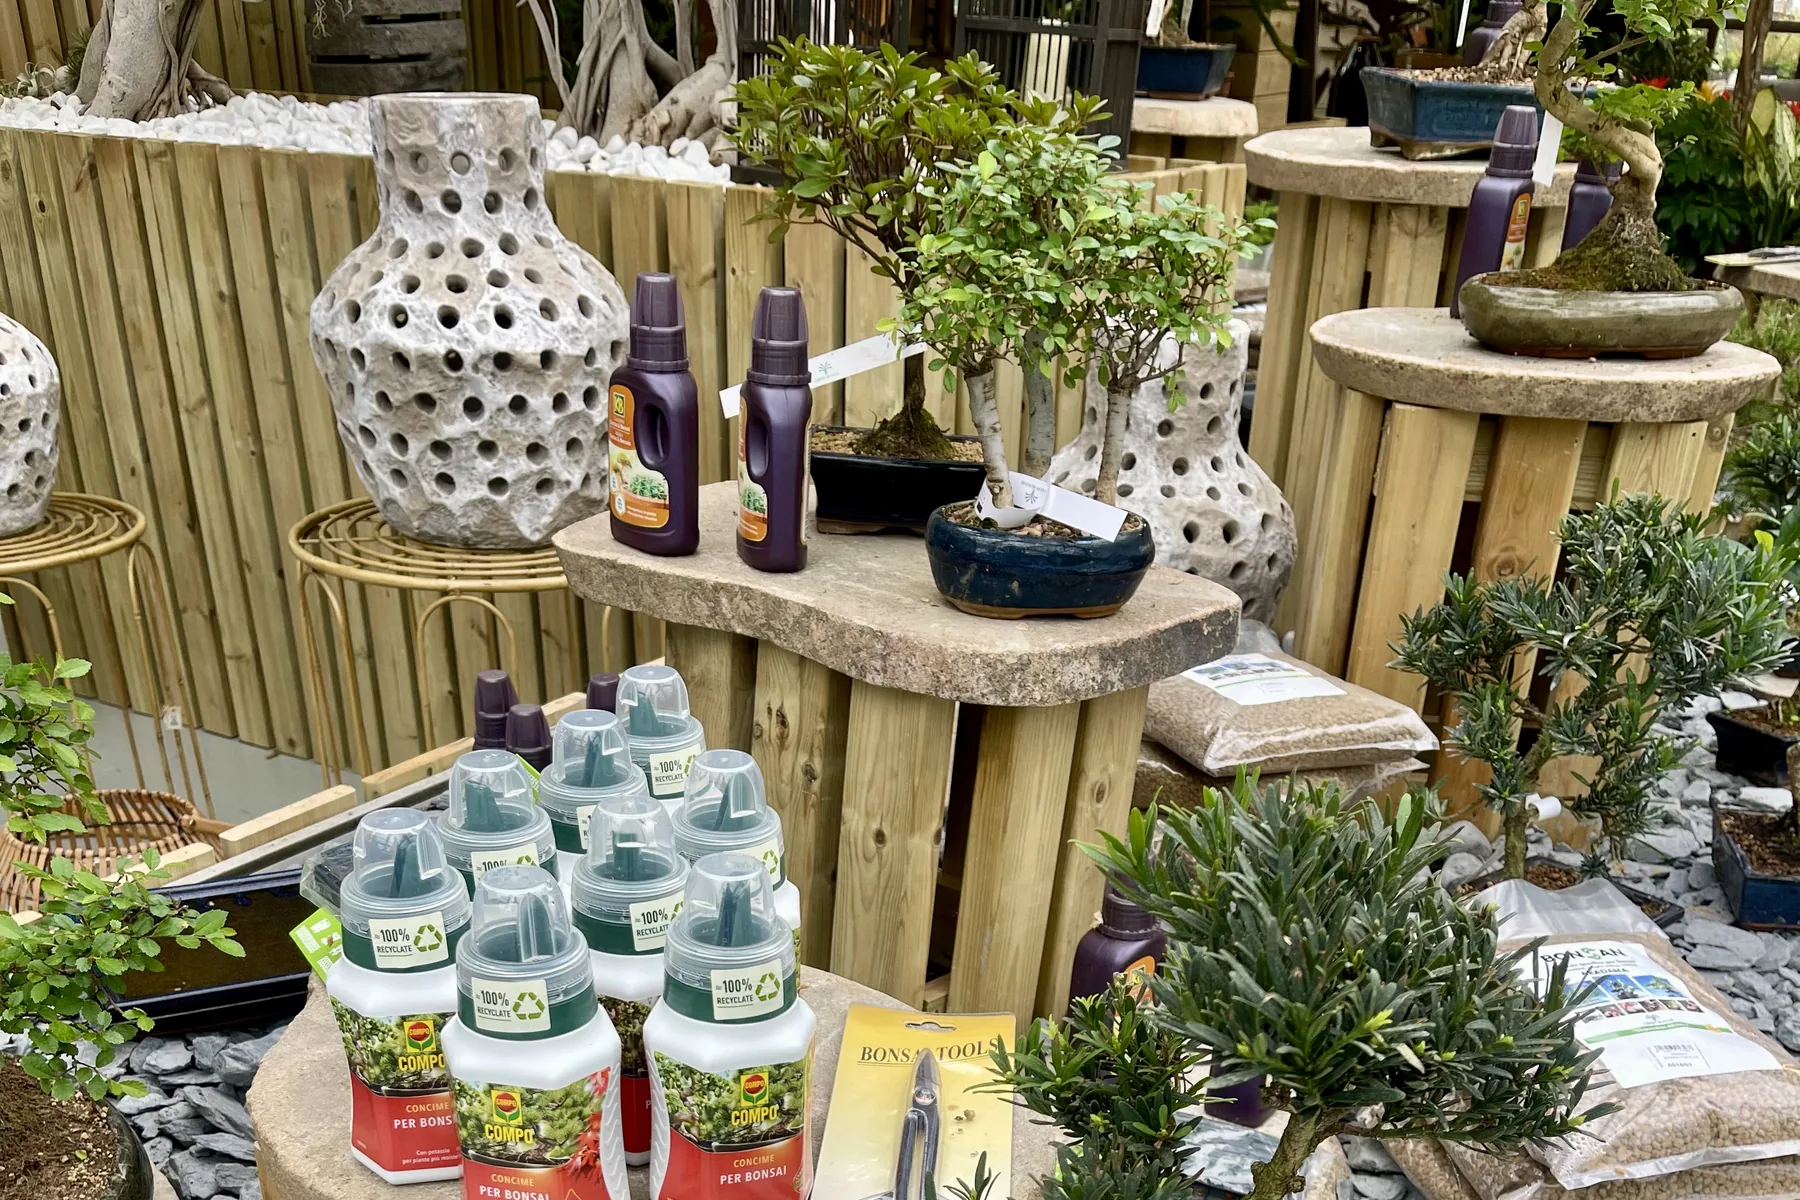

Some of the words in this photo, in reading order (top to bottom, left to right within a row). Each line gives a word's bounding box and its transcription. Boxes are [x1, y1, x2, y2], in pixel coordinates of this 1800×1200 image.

[660, 759, 682, 773] 100%
[655, 773, 683, 783] RECYCLATE
[641, 908, 668, 925] 100%
[380, 928, 410, 942] 100%
[376, 945, 412, 953] RECYCLATE
[723, 978, 752, 993] 100%
[481, 990, 509, 1006] 100%
[717, 995, 754, 1004] RECYCLATE
[477, 1006, 511, 1018] RECYCLATE
[409, 1028, 430, 1036] COMPO
[861, 1046, 920, 1062] BONSA
[936, 1037, 998, 1061] TOOLS
[398, 1053, 446, 1071] COMPO
[745, 1080, 765, 1089] COMPO
[406, 1102, 450, 1113] CONCIME
[496, 1098, 517, 1107] COMPO
[394, 1118, 416, 1129] PER
[420, 1115, 453, 1128] BONS
[731, 1105, 778, 1126] COMPO
[484, 1124, 534, 1144] COMPO
[733, 1154, 775, 1168] CONCIME
[491, 1173, 535, 1187] CONCIME
[720, 1173, 741, 1185] PER
[745, 1165, 787, 1182] BONSAI
[480, 1185, 501, 1198] PER
